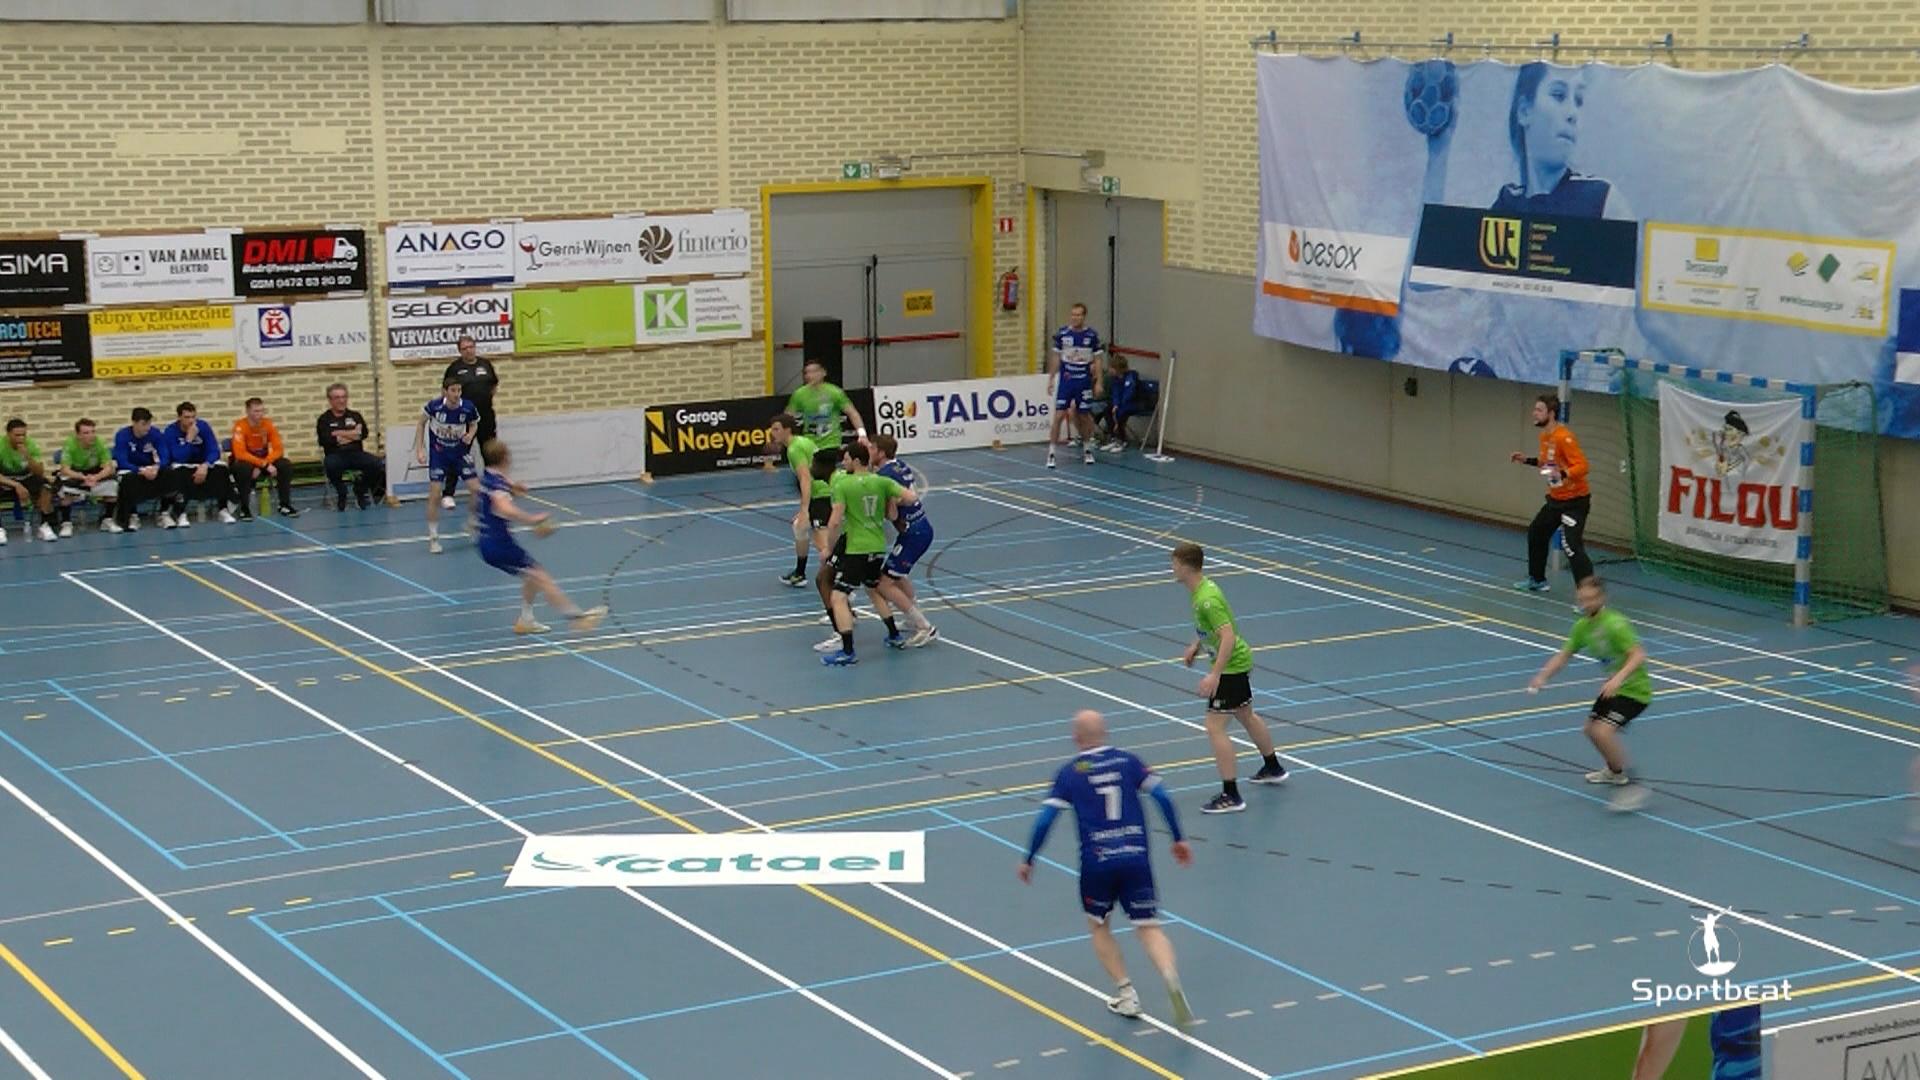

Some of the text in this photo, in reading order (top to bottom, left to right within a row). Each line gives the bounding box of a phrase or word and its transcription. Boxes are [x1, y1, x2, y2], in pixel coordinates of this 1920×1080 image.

[243, 238, 308, 266] DMI
[396, 229, 505, 253] ANAGO
[539, 239, 632, 258] Gerni-Wijnen
[678, 228, 748, 253] finterio
[1302, 230, 1362, 271] besox
[149, 247, 227, 263] VAN AMMEL
[94, 313, 136, 325] RUDY
[299, 334, 321, 346] RIK
[337, 332, 367, 345] ANN
[676, 408, 728, 427] Garage
[878, 400, 905, 419] Q8
[926, 389, 1049, 425] TALO.be
[677, 424, 774, 455] Naeyaer
[880, 419, 917, 439] Oils
[861, 495, 878, 518] 17
[1667, 465, 1799, 530] FILOU
[616, 850, 906, 874] catael
